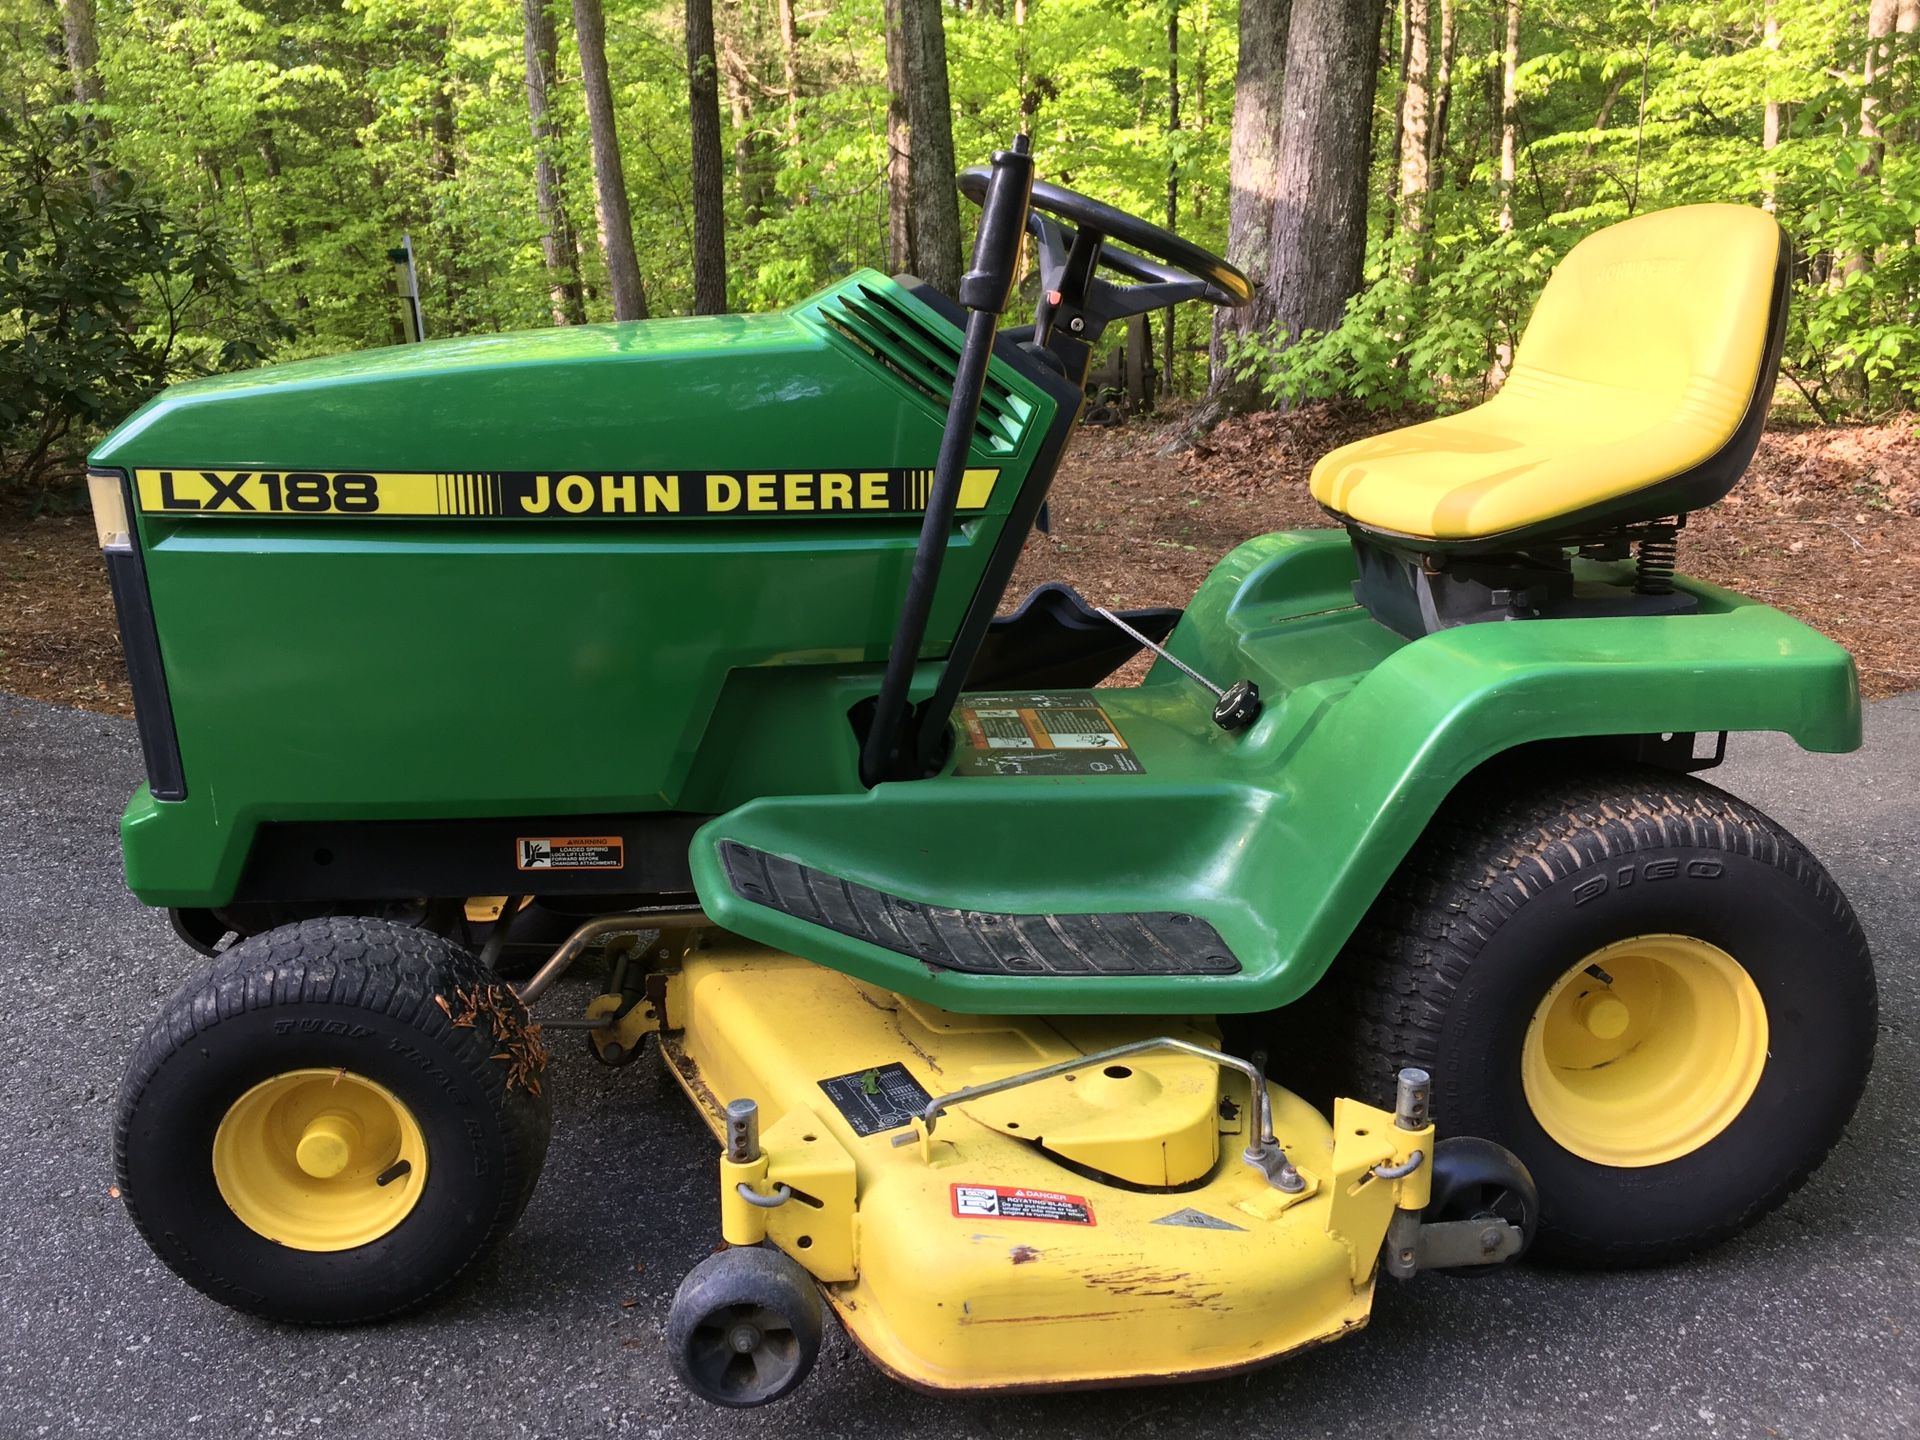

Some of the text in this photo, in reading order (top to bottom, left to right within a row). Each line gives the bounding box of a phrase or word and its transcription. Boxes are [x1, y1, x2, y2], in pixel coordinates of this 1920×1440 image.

[160, 472, 379, 512] LX188
[520, 472, 889, 513] JOHN DEERE
[273, 1018, 377, 1039] TURF
[389, 1037, 471, 1106] TRAC
[1007, 1197, 1046, 1206] ROTATING
[1026, 1191, 1067, 1201] DANGER
